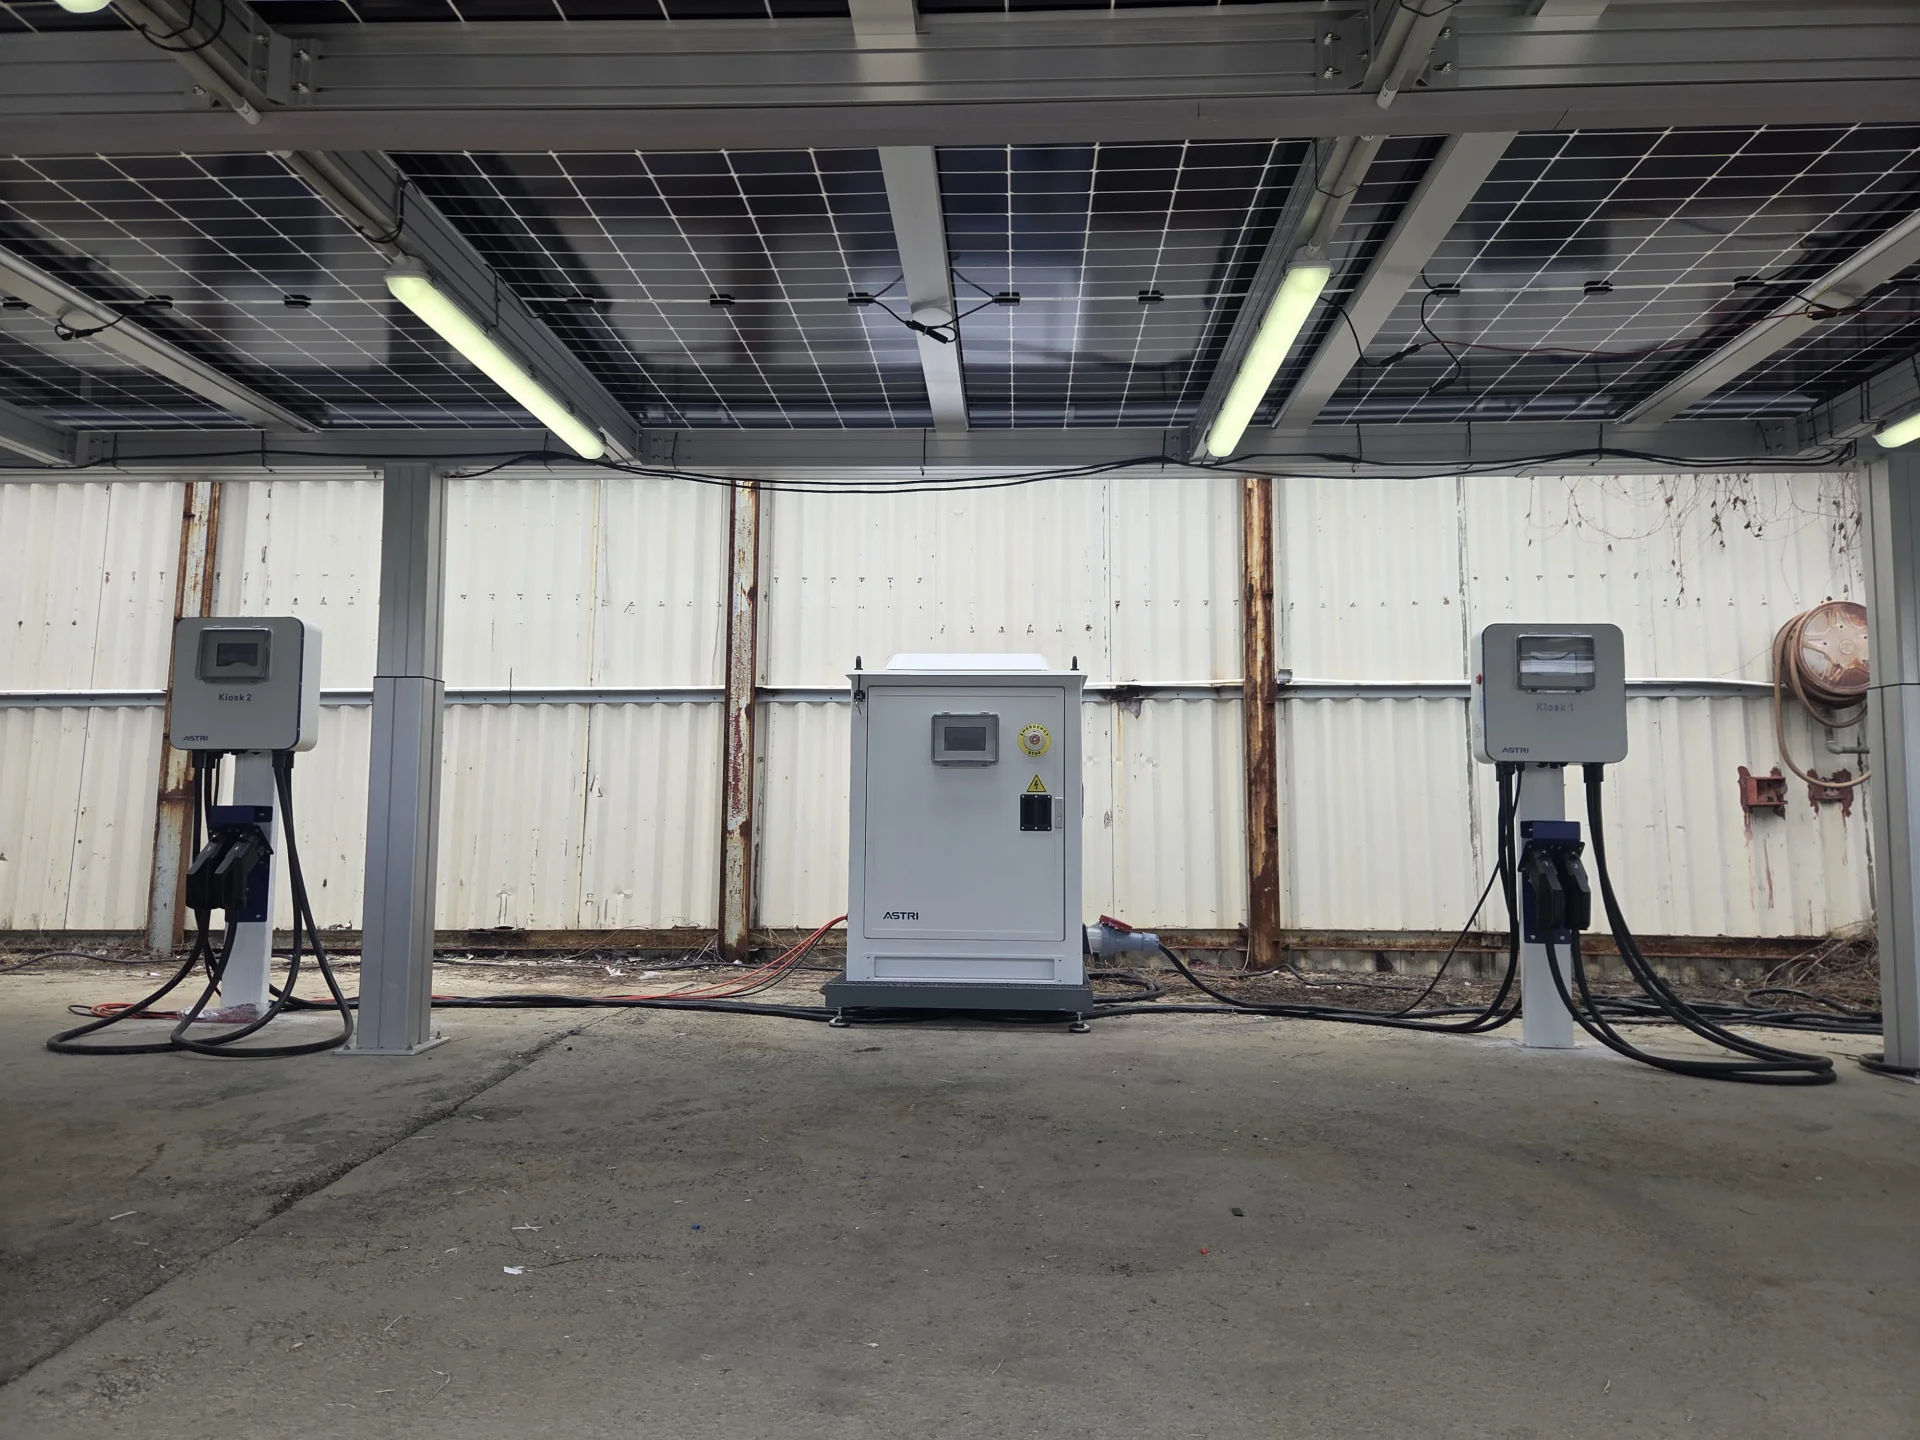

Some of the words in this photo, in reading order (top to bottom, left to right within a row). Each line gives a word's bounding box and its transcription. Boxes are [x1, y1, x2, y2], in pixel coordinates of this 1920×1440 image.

[218, 693, 245, 702] Kiosk
[246, 693, 252, 702] 2
[1536, 702, 1566, 712] Kiosk
[1568, 702, 1574, 712] 1
[1020, 724, 1049, 737] EMERGENCY
[882, 911, 919, 921] ASTRI
